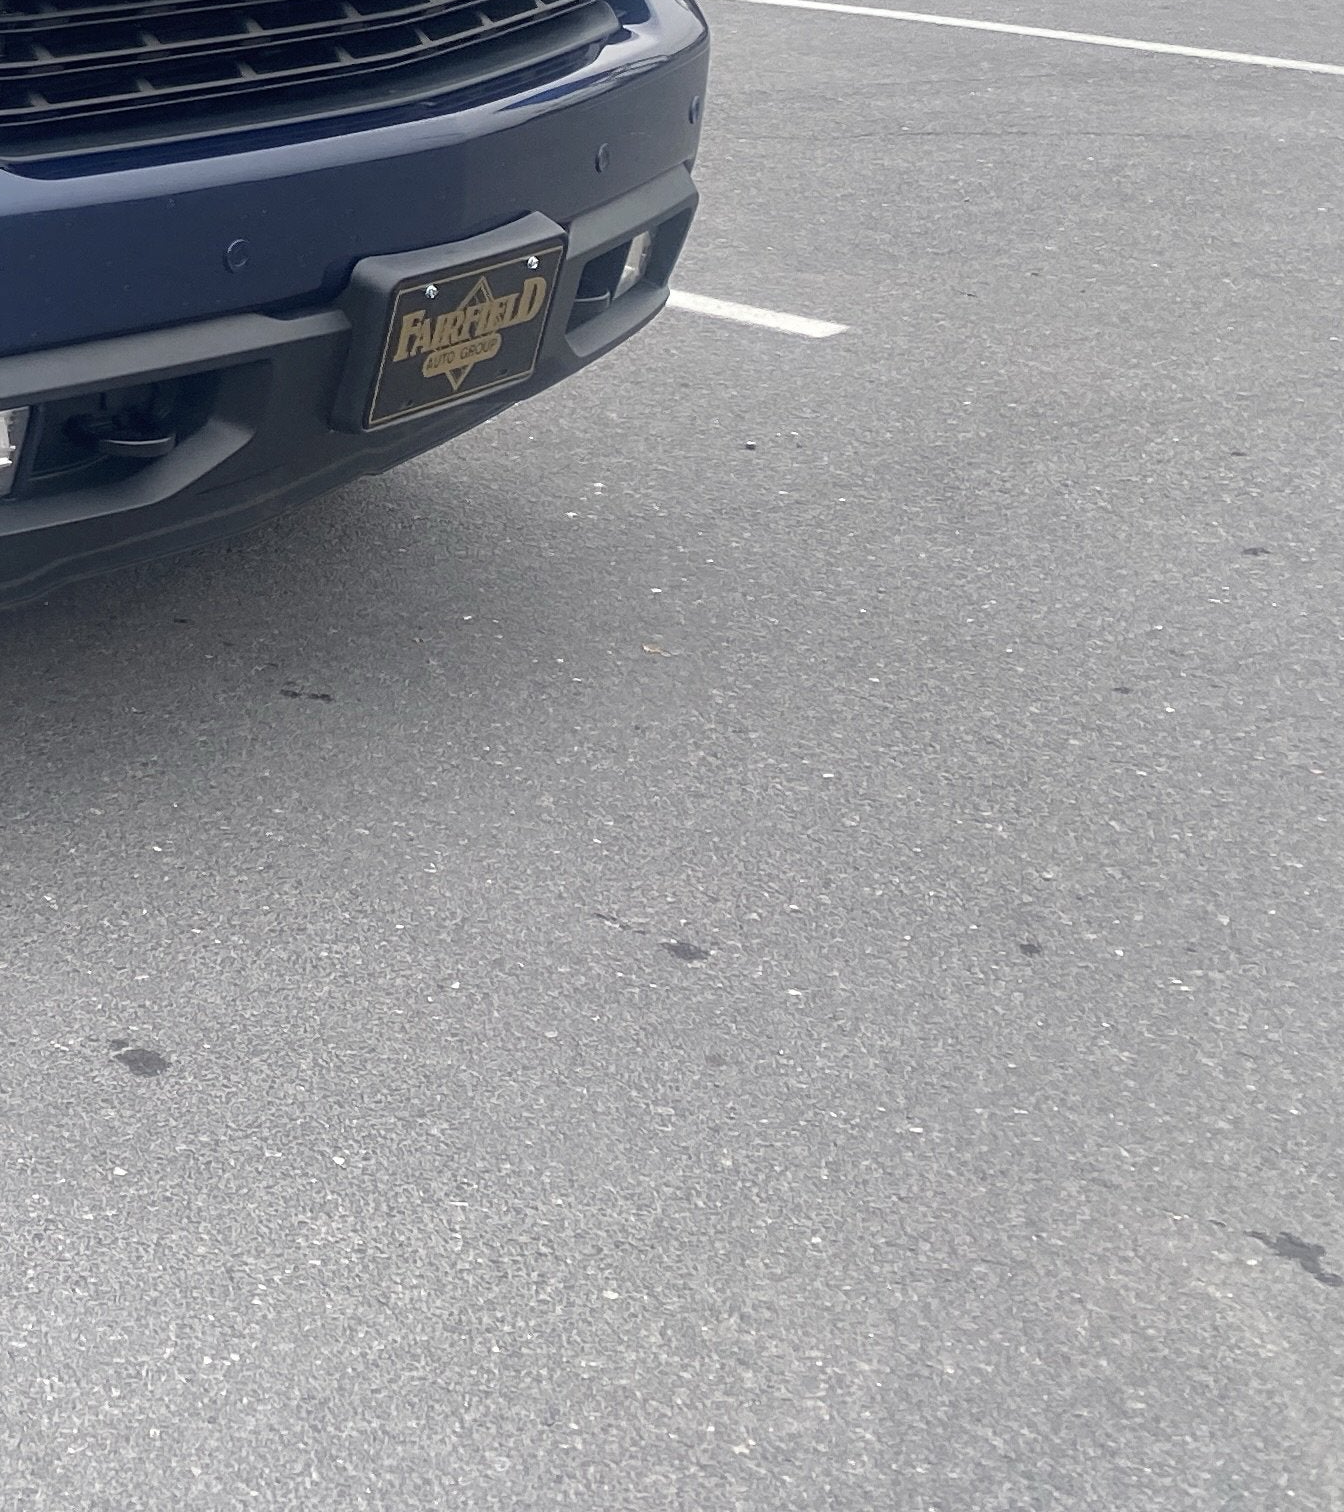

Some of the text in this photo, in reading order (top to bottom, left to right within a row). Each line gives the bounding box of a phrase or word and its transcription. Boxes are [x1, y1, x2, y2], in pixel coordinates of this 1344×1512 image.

[392, 276, 548, 363] FAIRFIELD
[425, 337, 499, 370] AUTO GROUP
